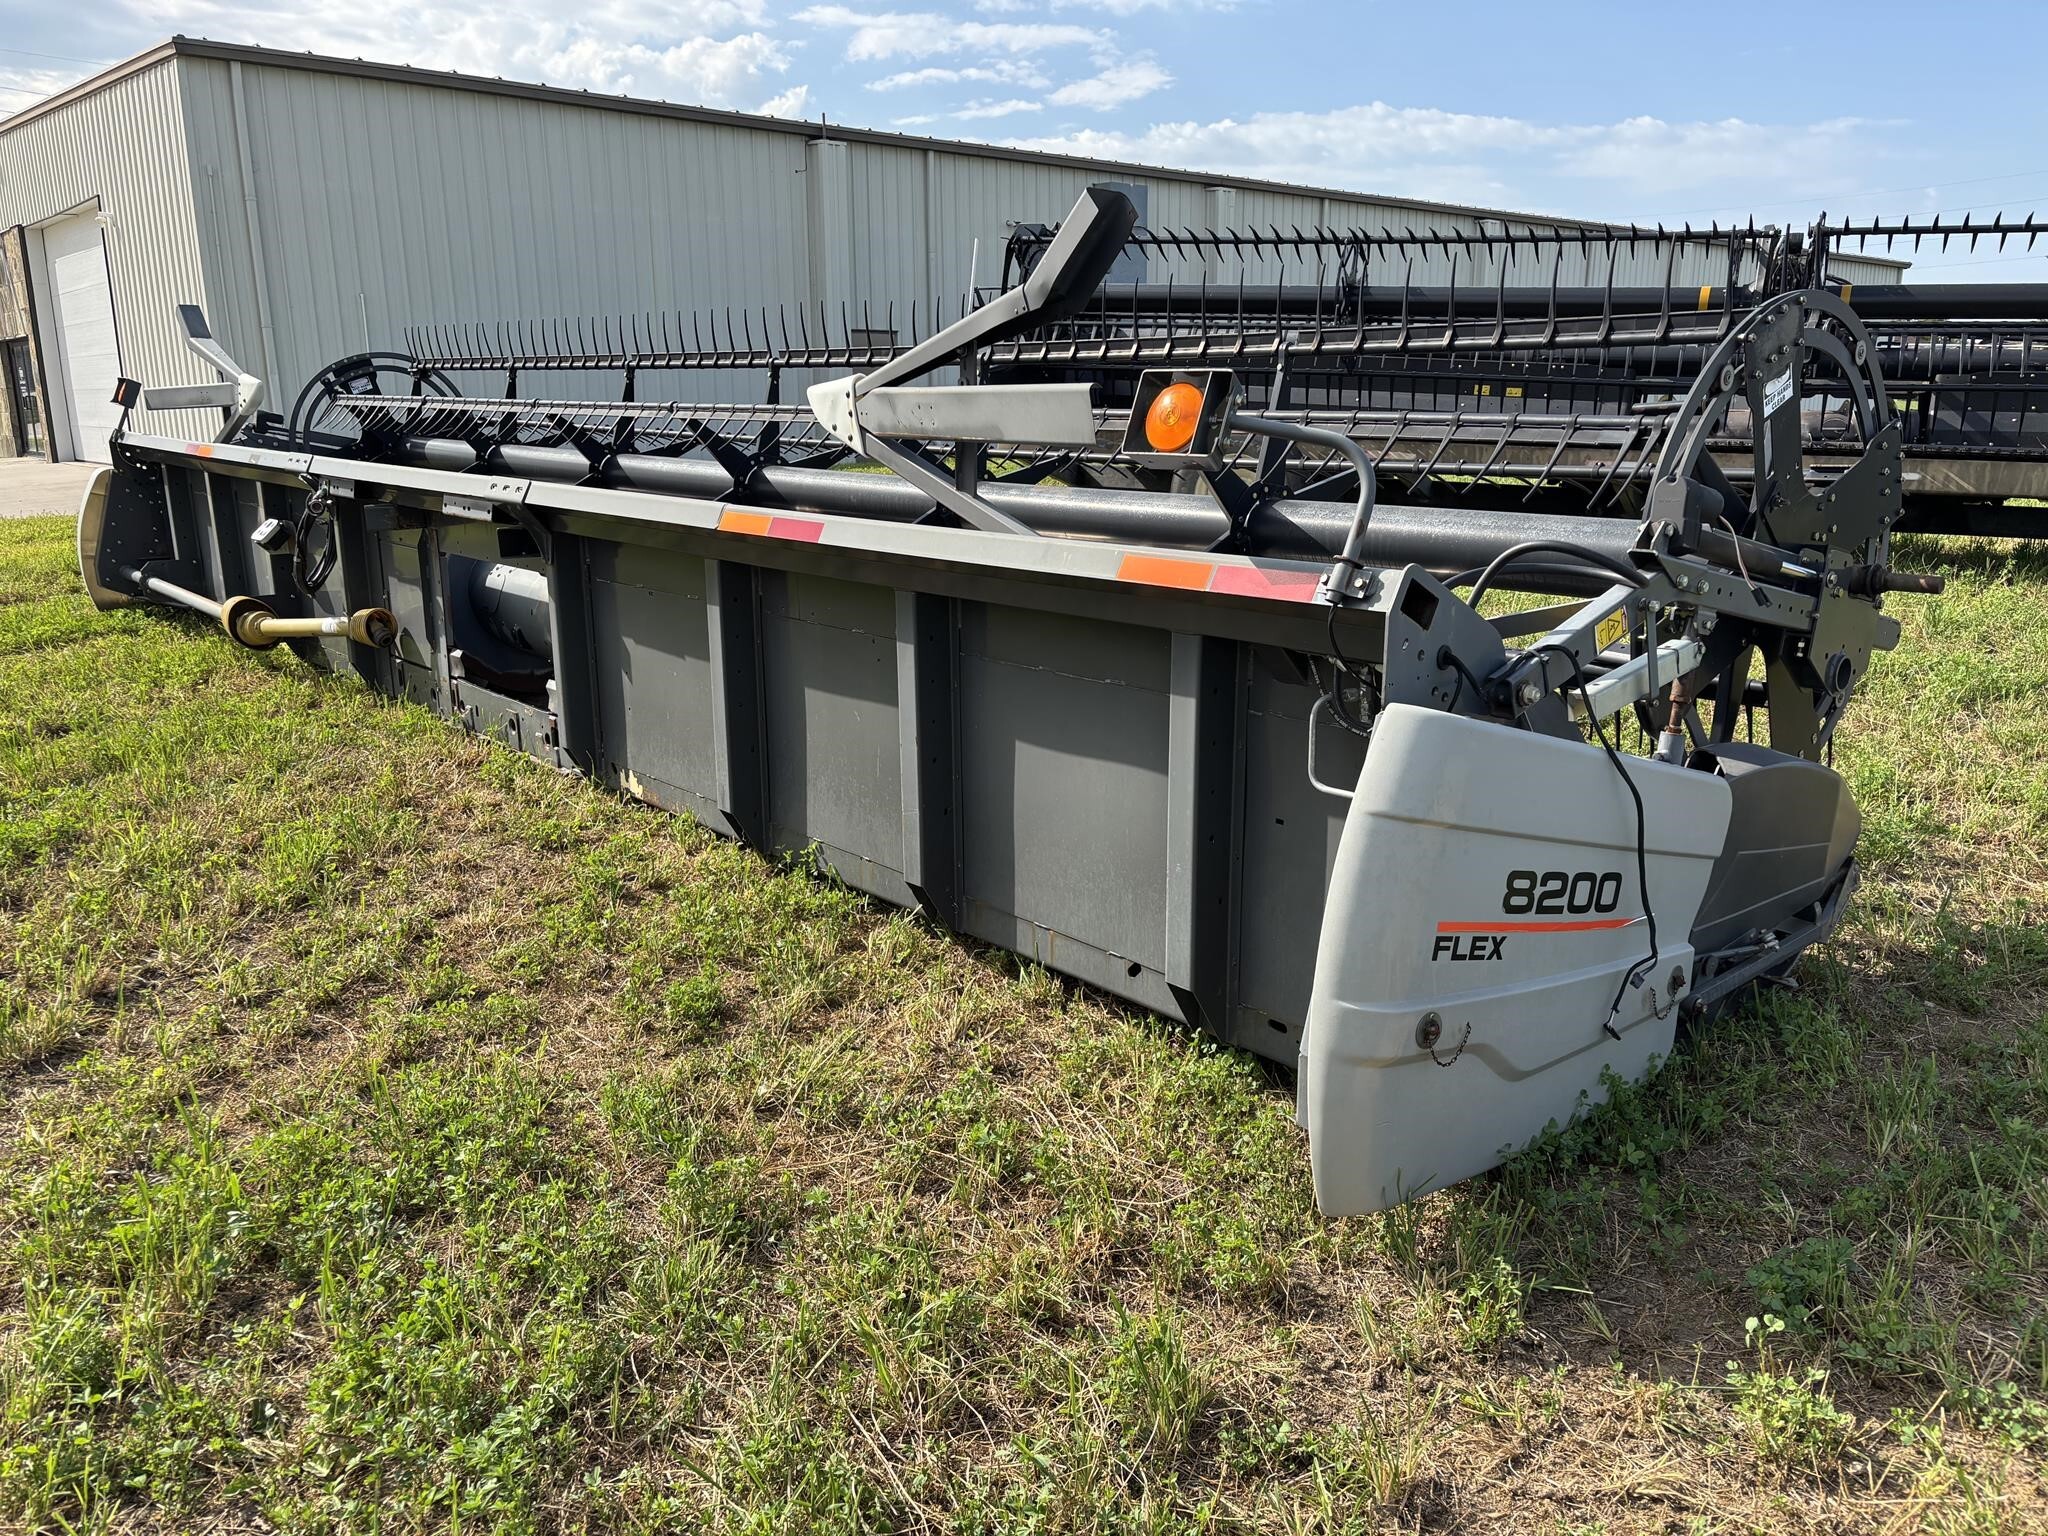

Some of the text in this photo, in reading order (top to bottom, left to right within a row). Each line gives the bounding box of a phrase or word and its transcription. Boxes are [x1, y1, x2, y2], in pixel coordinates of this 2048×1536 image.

[1765, 381, 1791, 406] KEEP HANDS
[1772, 394, 1786, 410] CLEAR
[1502, 870, 1622, 914] 8200
[1432, 936, 1507, 961] FLEX
